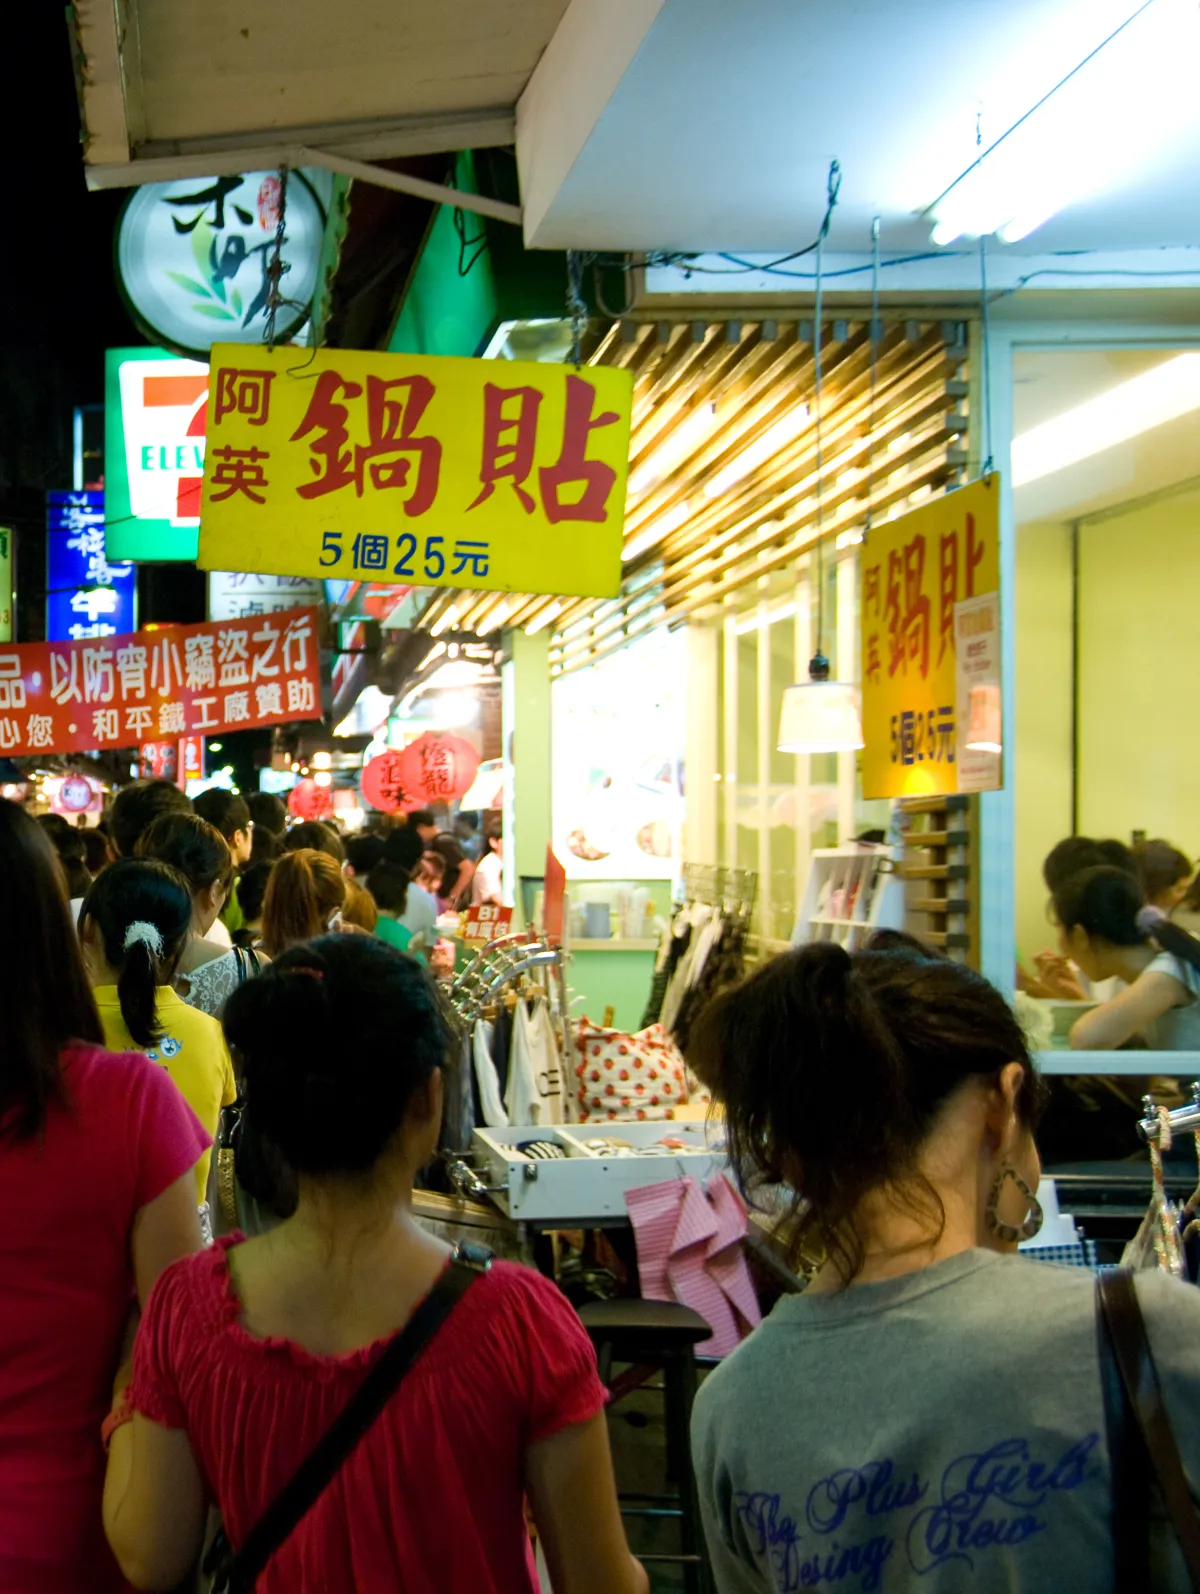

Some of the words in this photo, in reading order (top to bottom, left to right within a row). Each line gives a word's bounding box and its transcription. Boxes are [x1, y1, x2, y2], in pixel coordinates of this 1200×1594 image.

[208, 368, 276, 505] 阿英
[289, 370, 621, 525] 鍋貼
[319, 531, 490, 578] 5個25元
[806, 1458, 930, 1534] Plus
